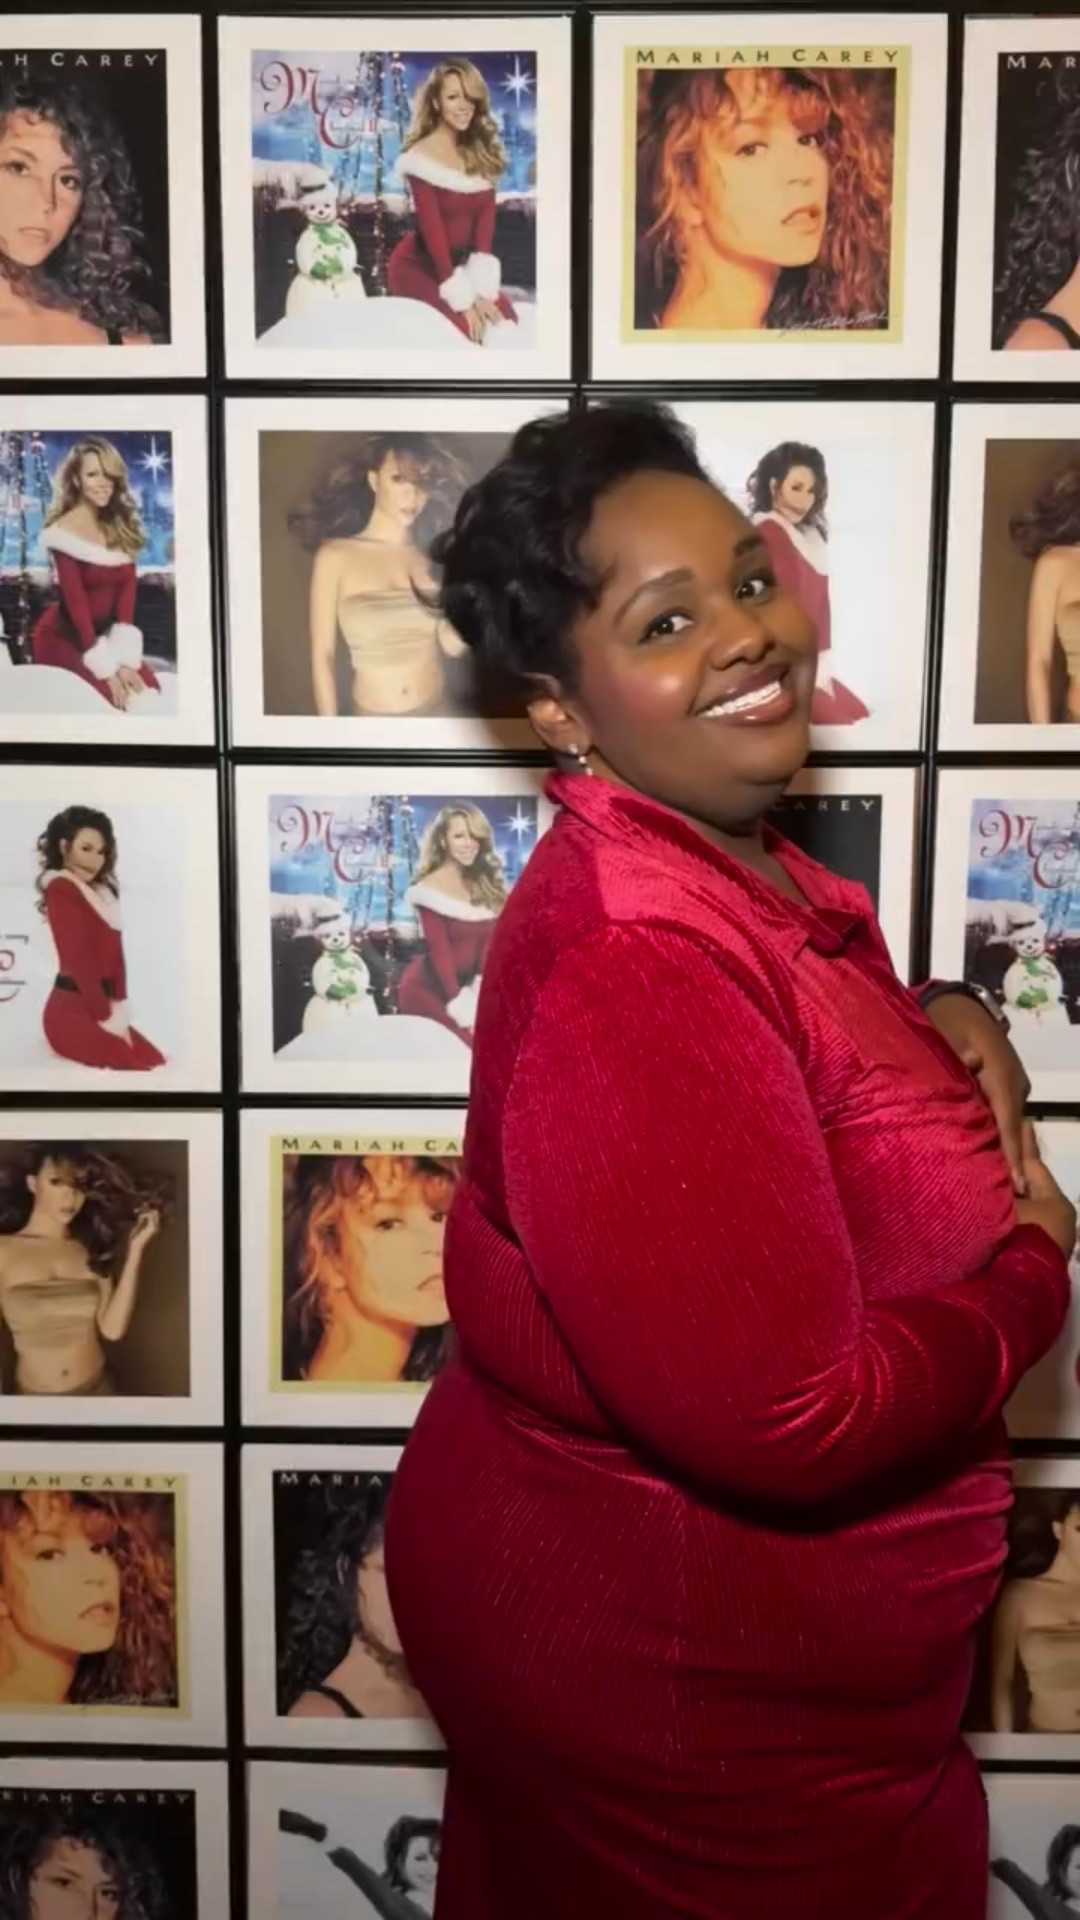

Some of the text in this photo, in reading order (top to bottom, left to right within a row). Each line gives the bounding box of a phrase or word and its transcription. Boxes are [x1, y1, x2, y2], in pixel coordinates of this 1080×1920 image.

[0, 51, 158, 67] H CAREY
[636, 48, 899, 64] MARIAH CAREY
[1007, 55, 1077, 69] MAR
[282, 1138, 458, 1152] MARIAH CA
[81, 1475, 177, 1488] CAREY
[280, 1472, 383, 1487] MARIA
[92, 1792, 189, 1804] CAREY
